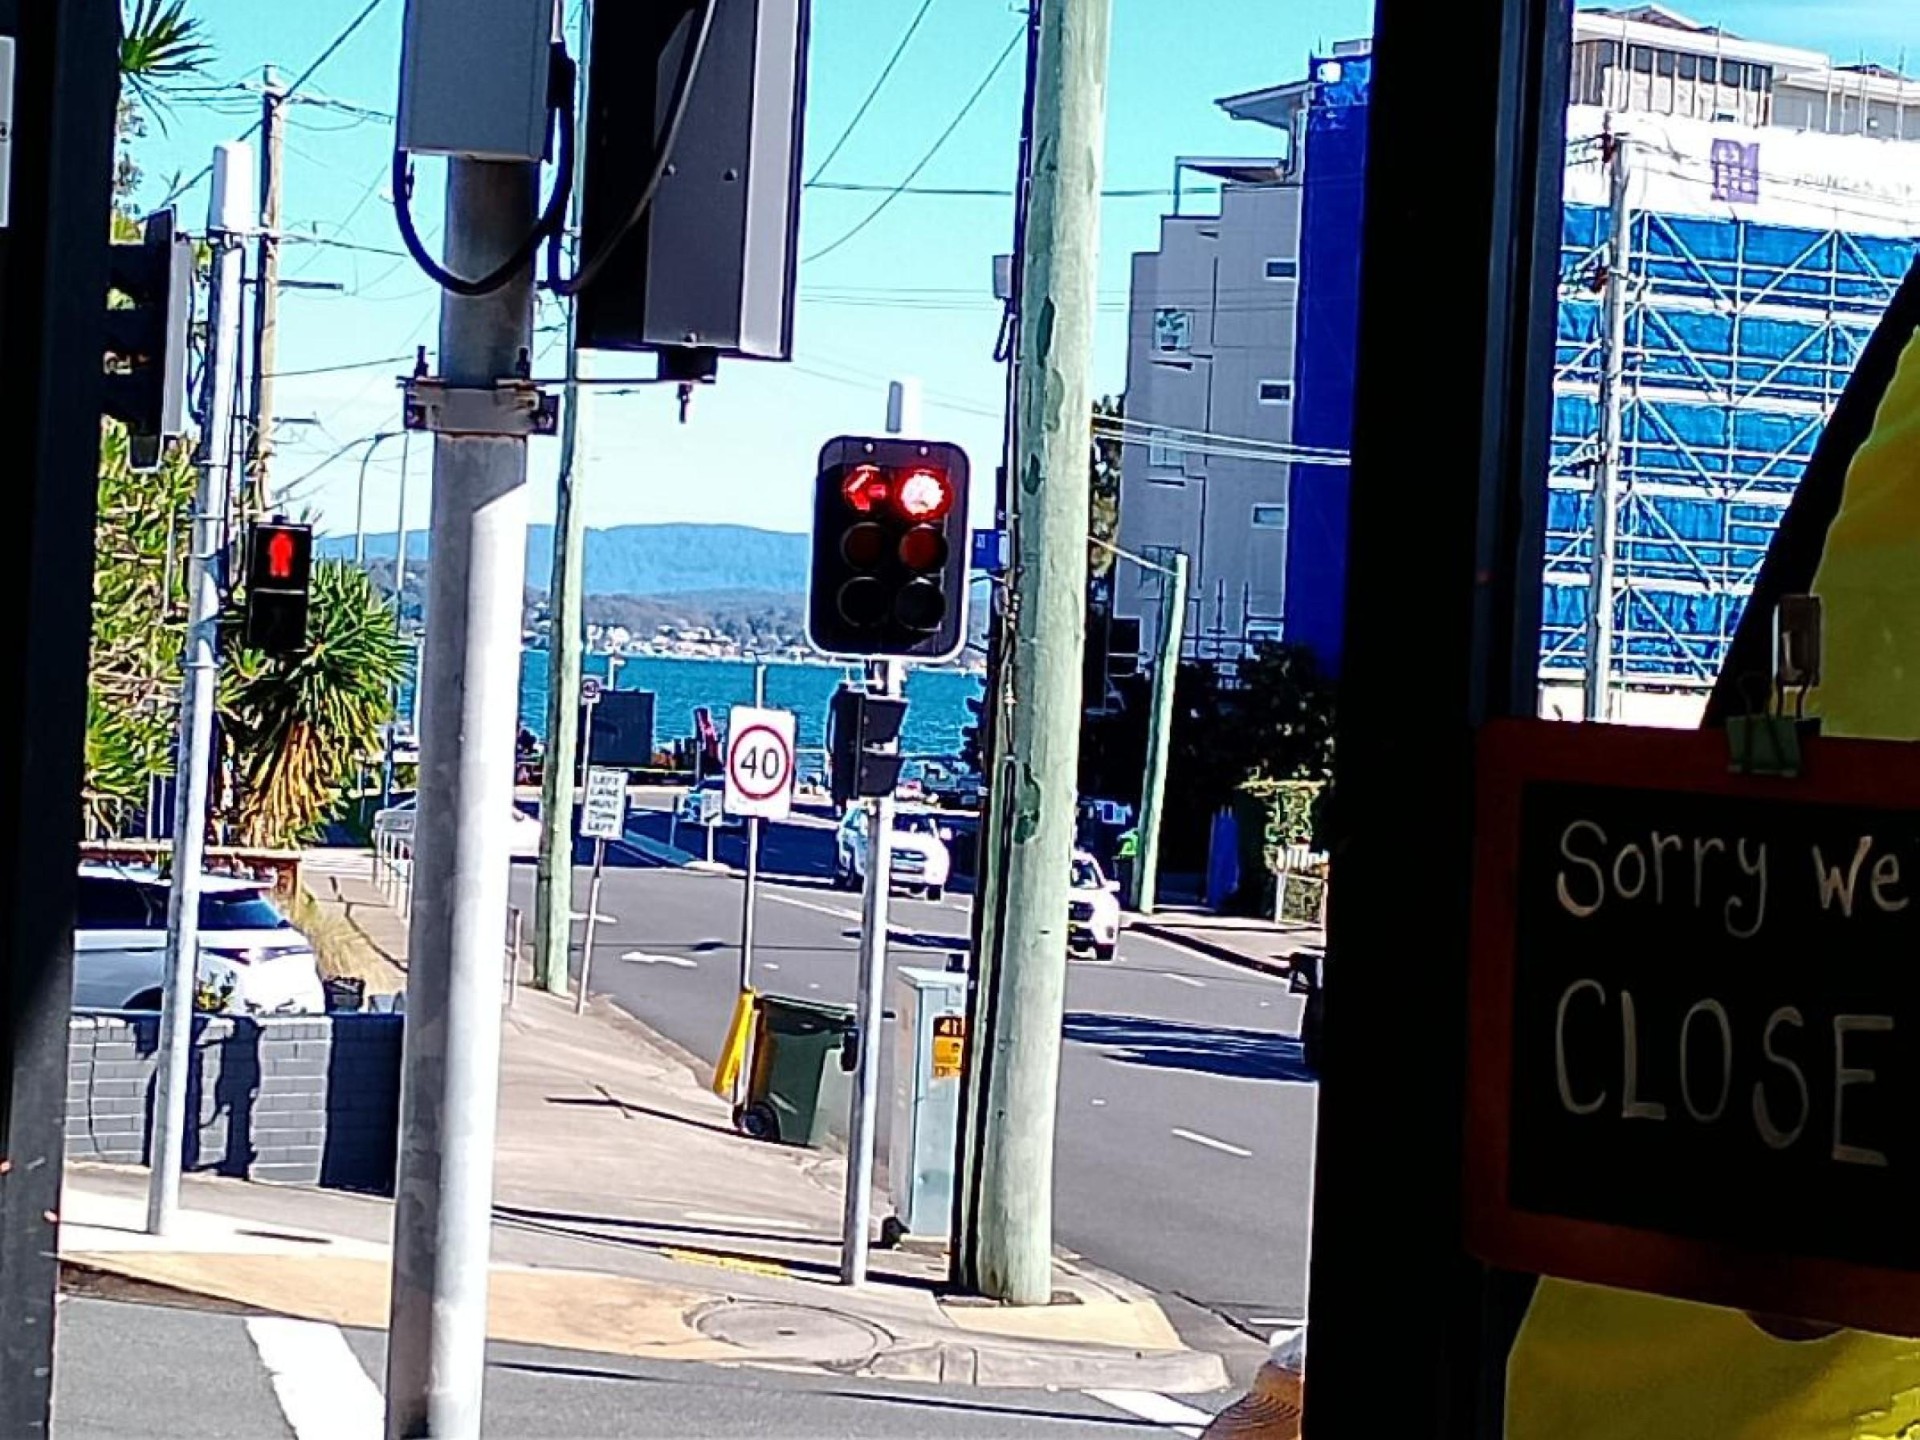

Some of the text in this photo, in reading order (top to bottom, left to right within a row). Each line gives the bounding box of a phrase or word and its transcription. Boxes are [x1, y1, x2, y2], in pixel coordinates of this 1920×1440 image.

[740, 746, 780, 779] 40
[593, 775, 618, 785] LEFT
[587, 820, 614, 832] LEFT
[1556, 819, 1768, 939] Sorry
[1555, 978, 1895, 1167] CLOSE
